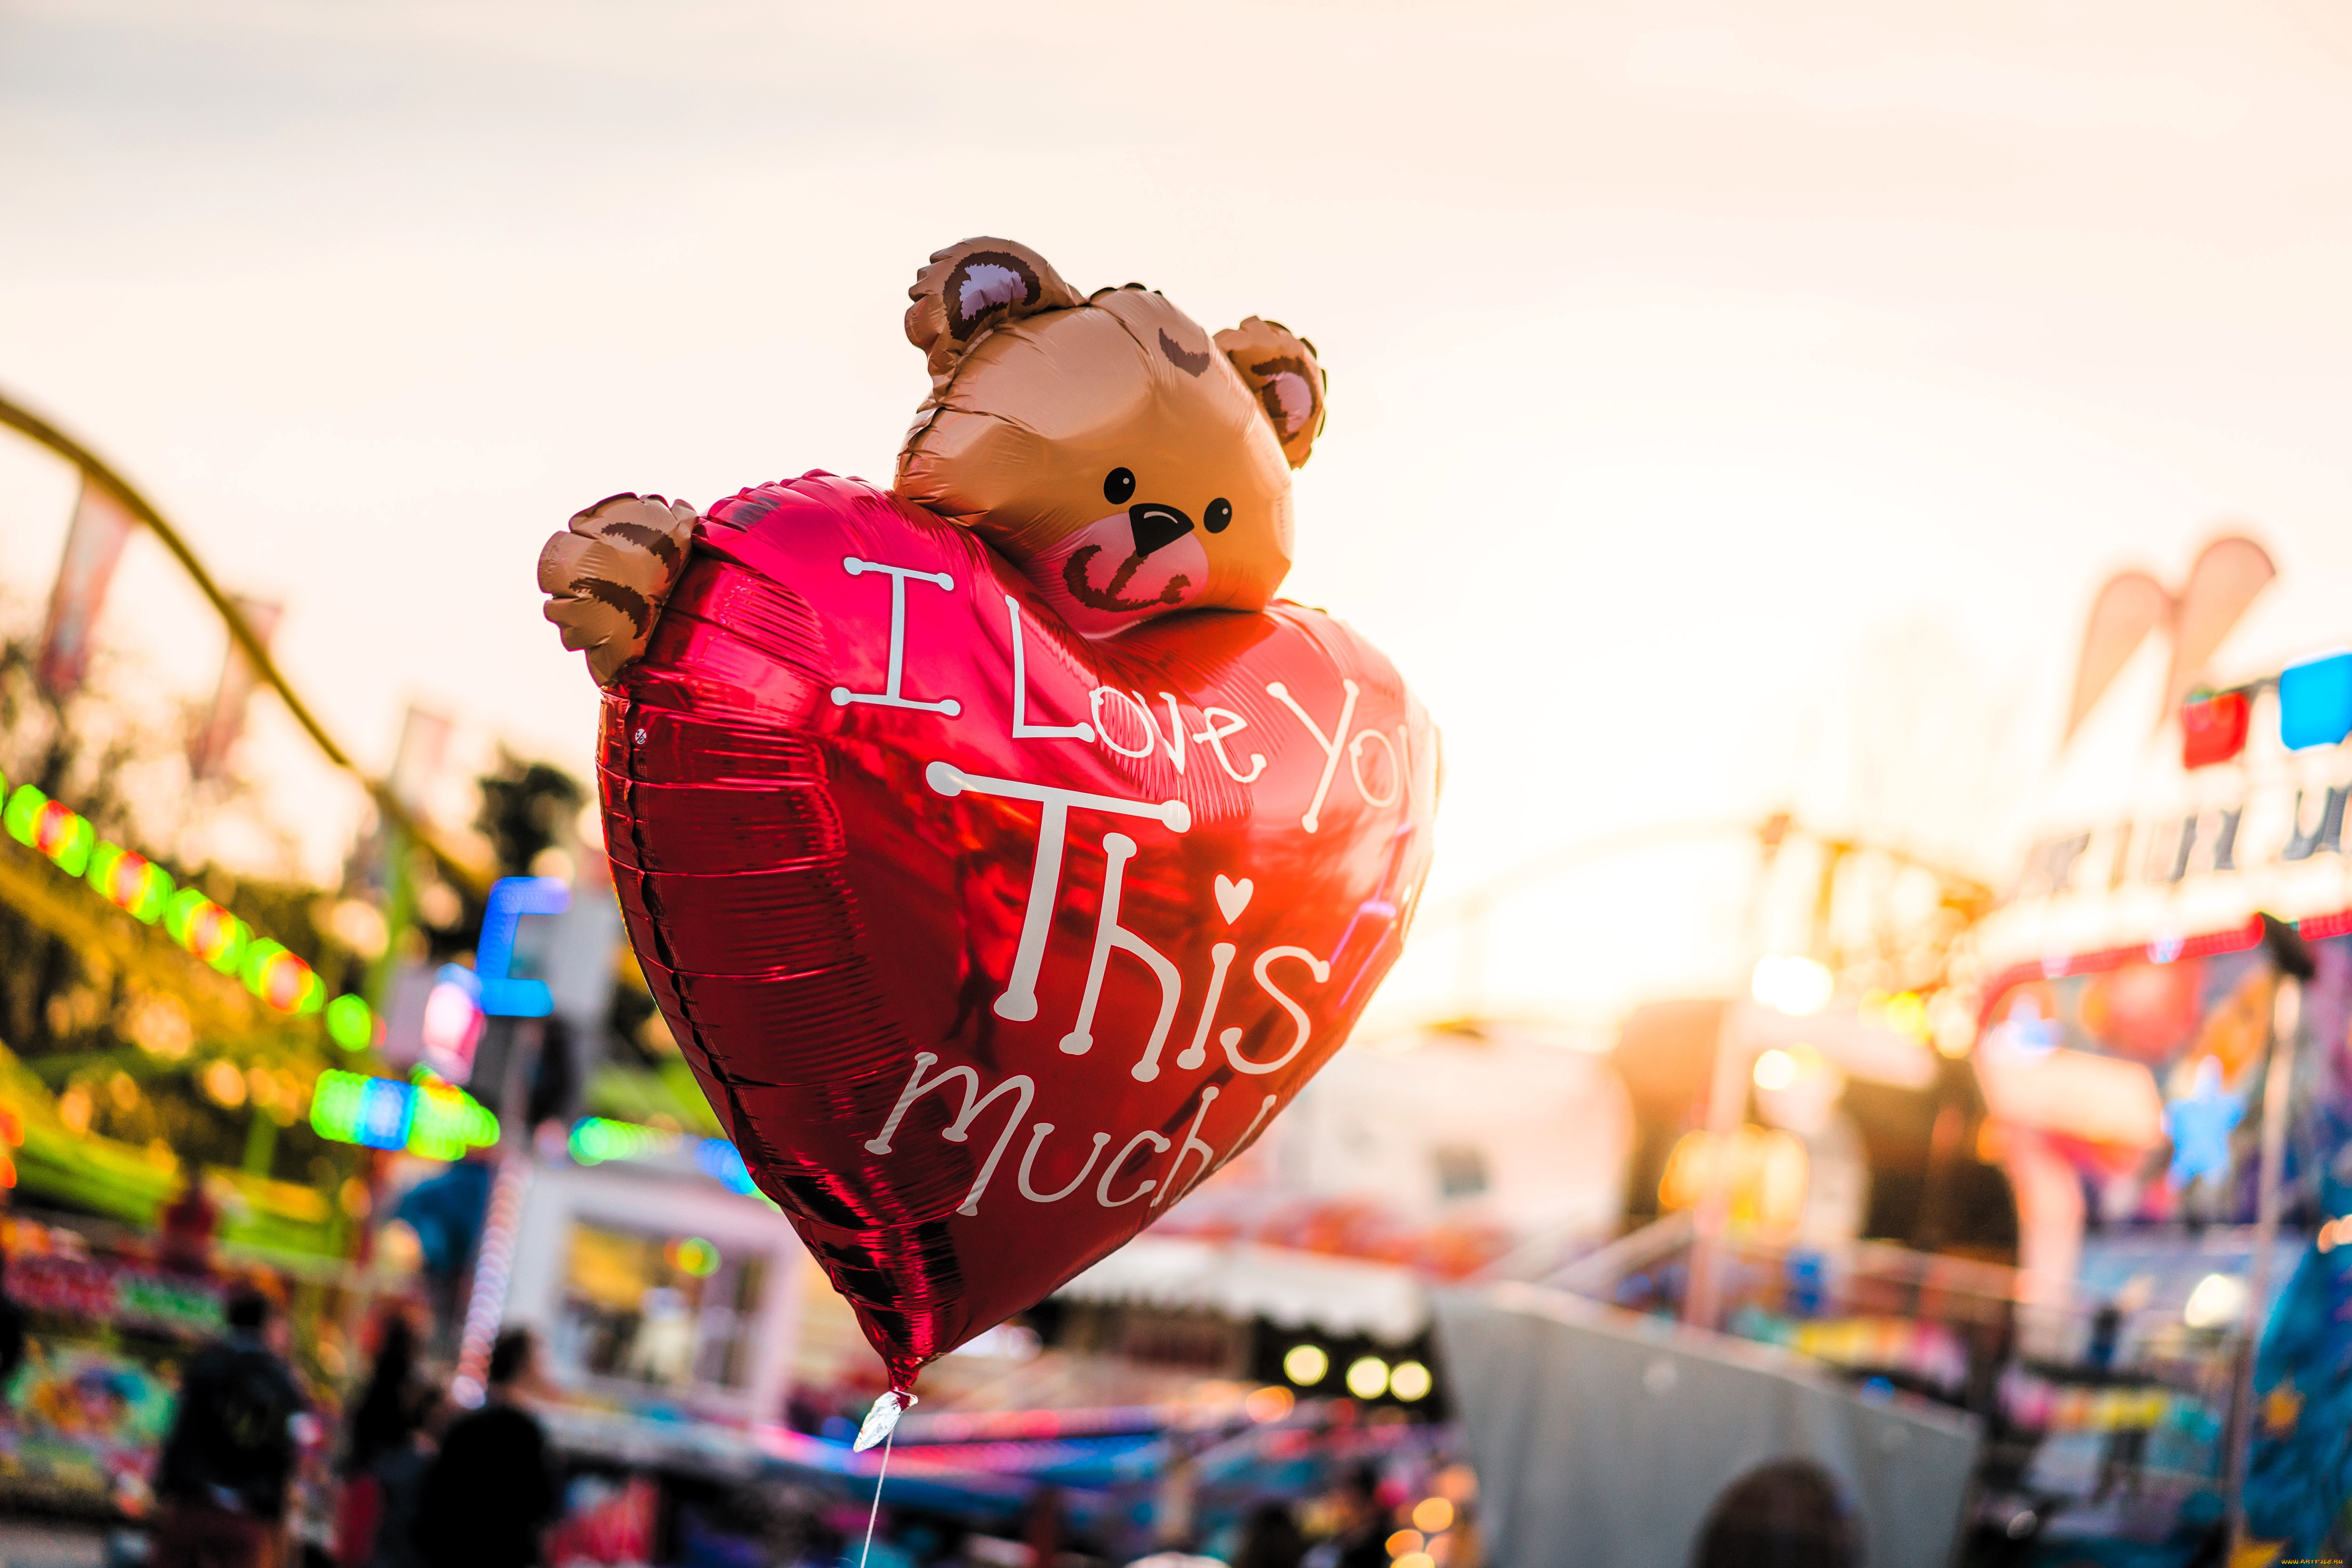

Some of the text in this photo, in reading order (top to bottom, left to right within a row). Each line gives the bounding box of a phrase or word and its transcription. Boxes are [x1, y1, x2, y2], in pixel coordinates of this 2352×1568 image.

[830, 557, 961, 716] I
[1005, 595, 1266, 784] Love
[926, 761, 1330, 1082] This
